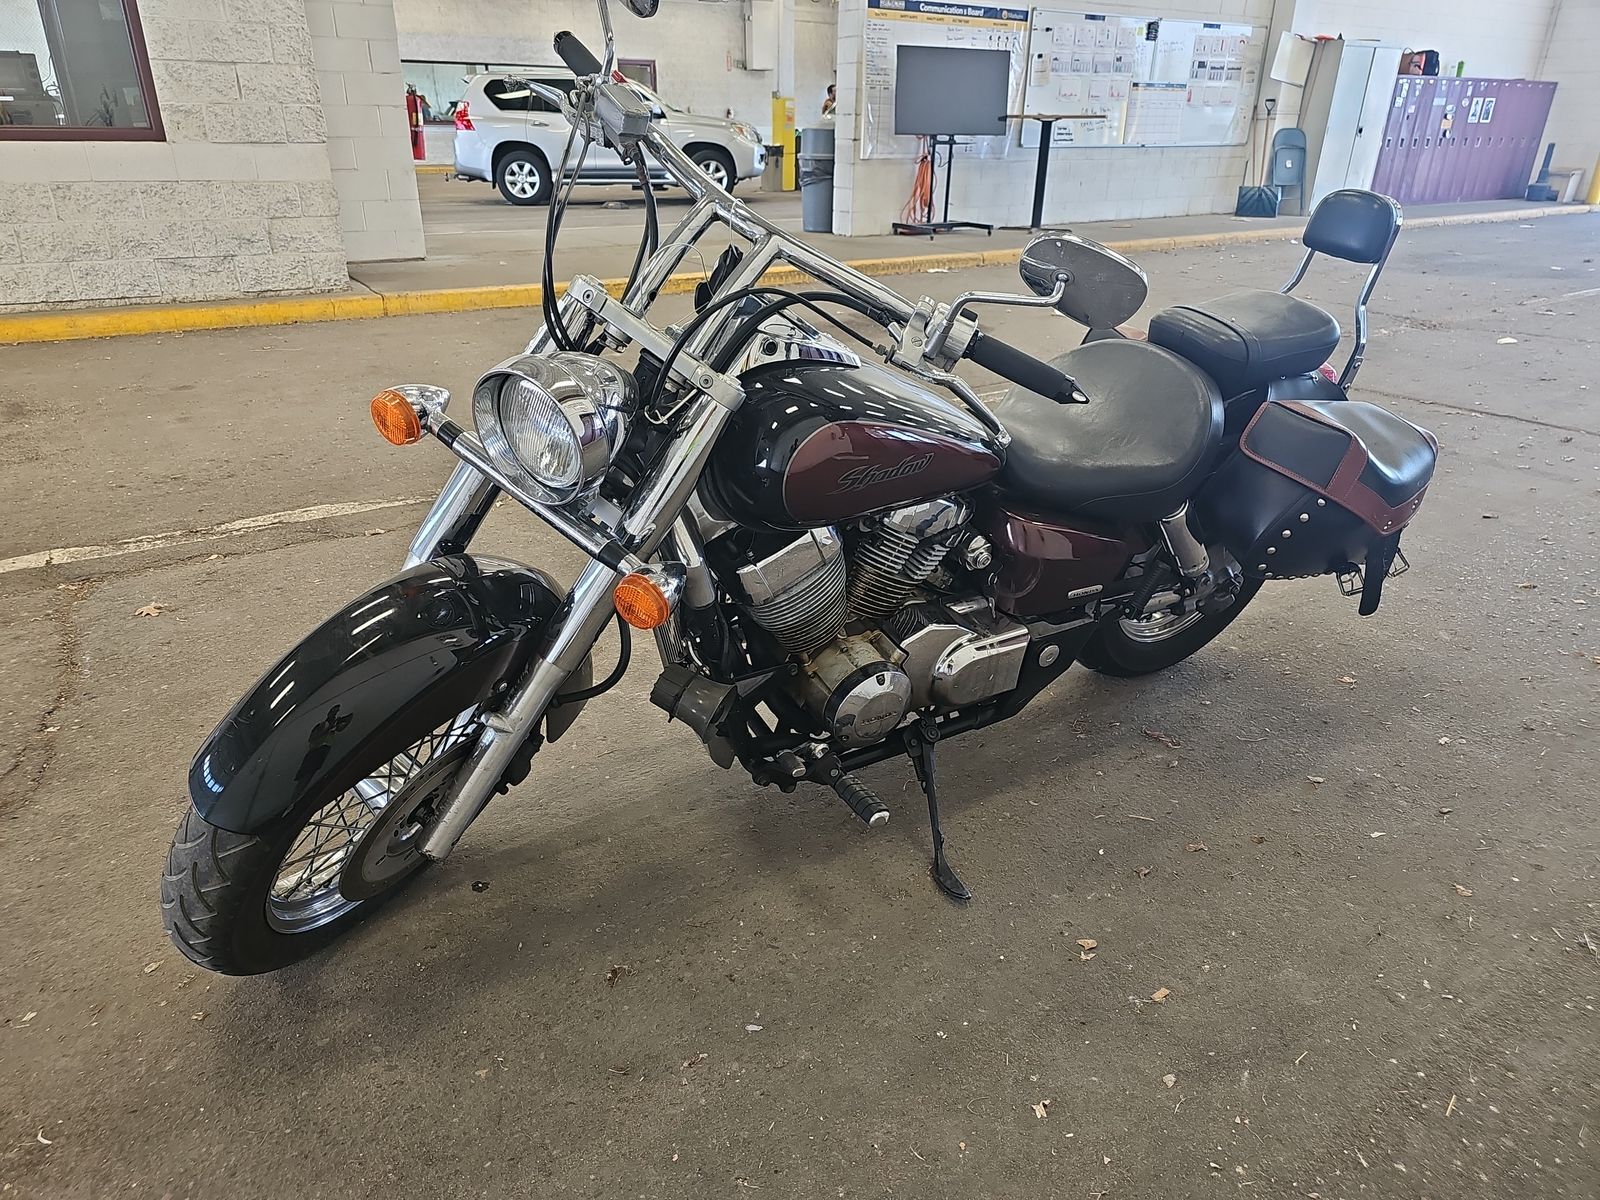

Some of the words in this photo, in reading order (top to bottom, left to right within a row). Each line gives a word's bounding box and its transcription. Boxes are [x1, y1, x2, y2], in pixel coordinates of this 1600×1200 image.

[967, 7, 984, 17] Board
[826, 452, 935, 495] Shadow
[1072, 588, 1099, 597] HONDA
